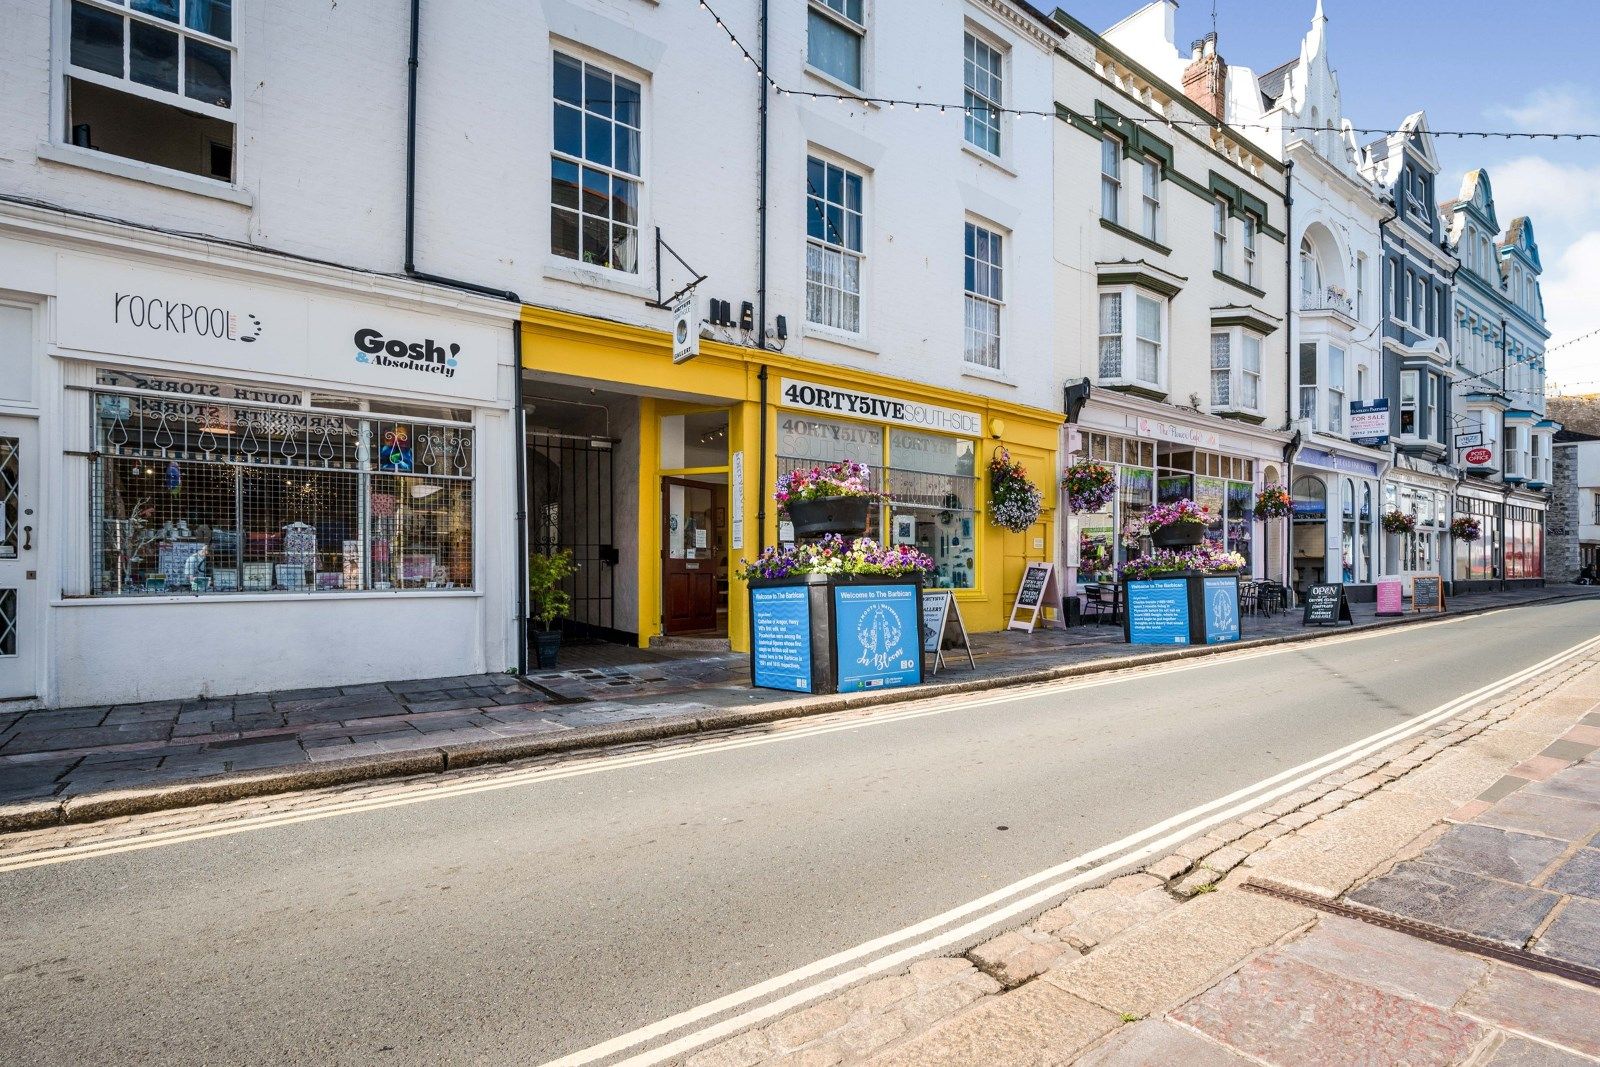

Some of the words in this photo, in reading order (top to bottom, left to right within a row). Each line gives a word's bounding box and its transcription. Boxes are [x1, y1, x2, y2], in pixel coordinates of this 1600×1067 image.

[354, 328, 460, 367] Gosh!
[355, 351, 369, 363] &
[371, 355, 455, 377] Absolutely
[887, 590, 911, 598] Barbican
[871, 647, 904, 671] Bloom
